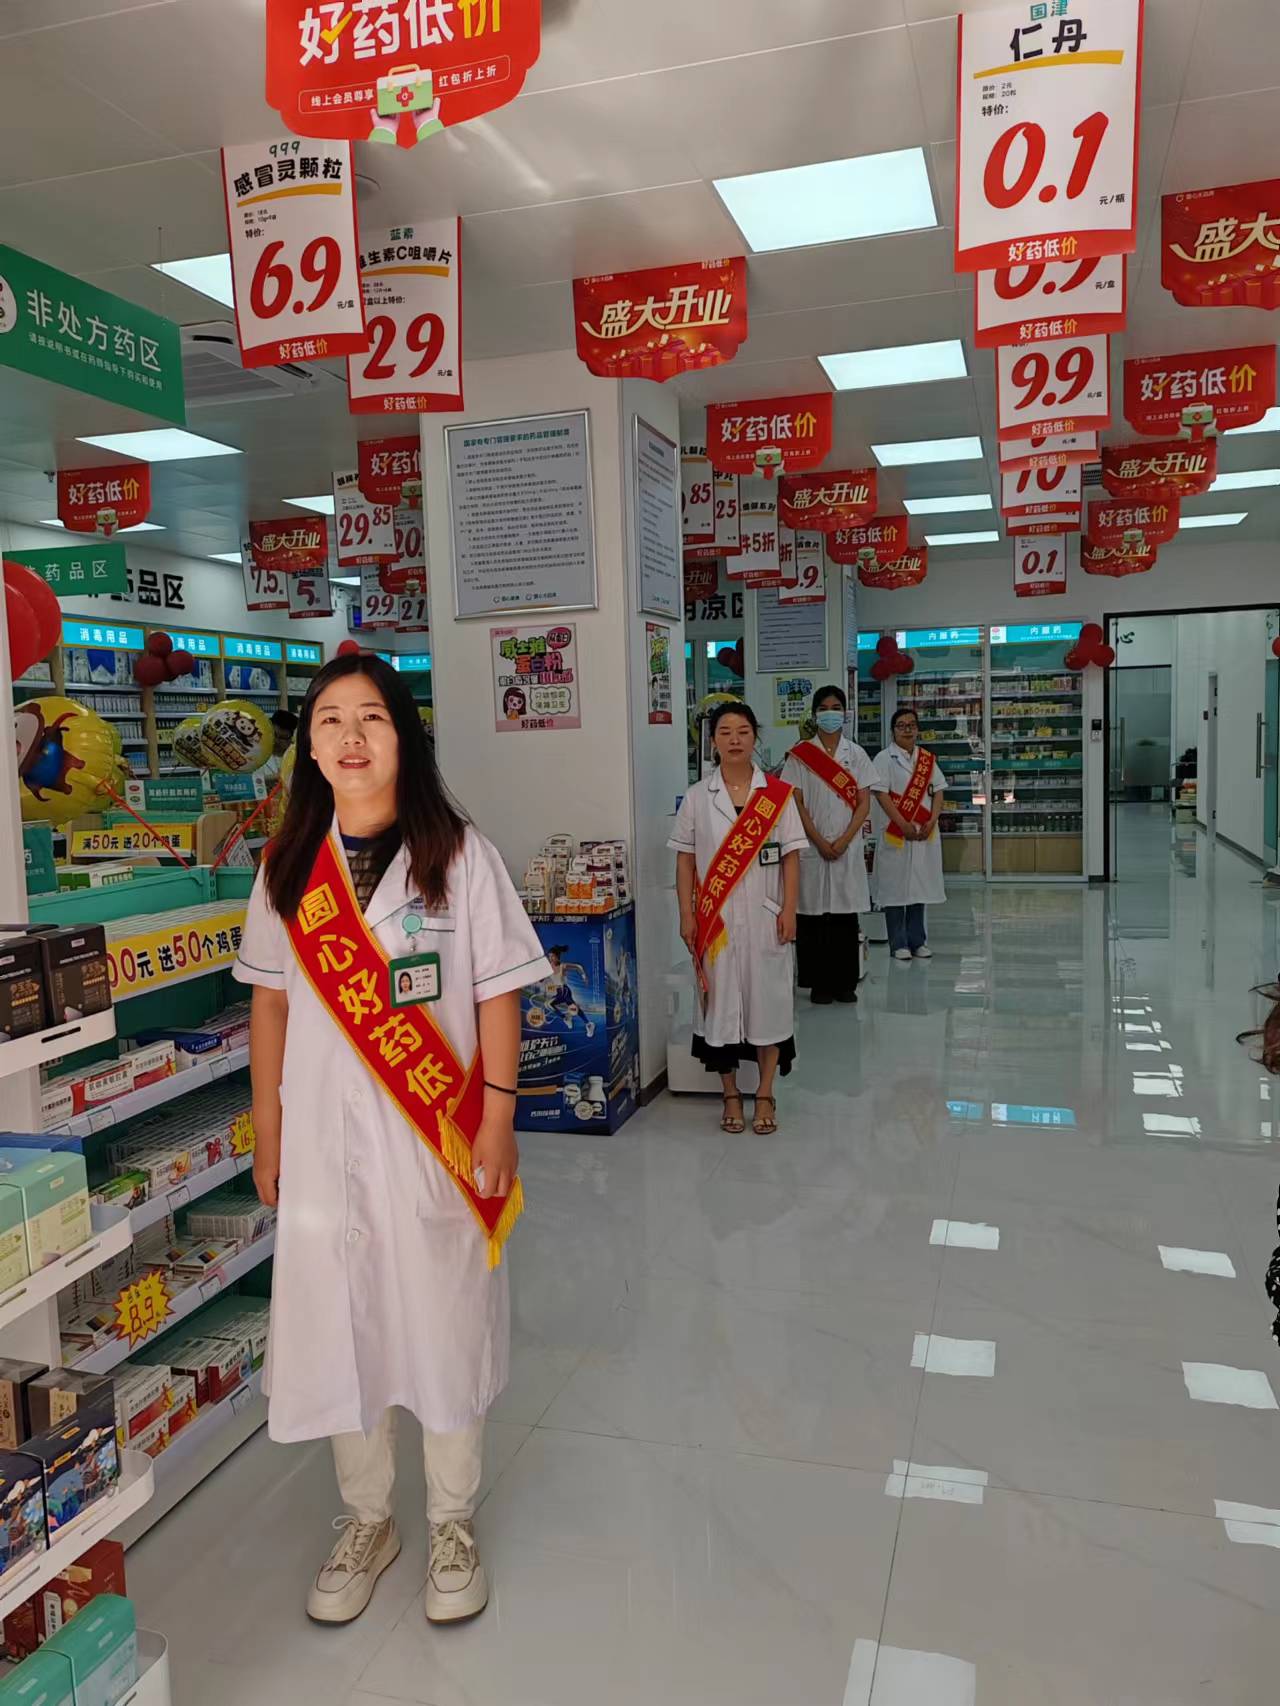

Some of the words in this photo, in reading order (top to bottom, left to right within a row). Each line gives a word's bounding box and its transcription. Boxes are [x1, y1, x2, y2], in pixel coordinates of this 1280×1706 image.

[1009, 19, 1088, 62] 仁丹
[438, 65, 497, 87] 红包折上折
[311, 89, 374, 107] 线上会员尊享
[981, 104, 1009, 117] 特价:
[268, 140, 300, 158] 999
[983, 111, 1109, 209] 0.1
[233, 157, 343, 197] 感冒灵颗粒
[1099, 193, 1126, 206] 元/瓶
[1008, 236, 1078, 262] 好药低价
[250, 236, 341, 319] 6.9
[581, 285, 732, 339] 盛大开业
[27, 289, 162, 372] 非处方药区
[1019, 321, 1077, 341] 好药低价
[278, 338, 328, 360] 好药低价
[362, 313, 445, 380] 29
[1011, 346, 1094, 410] 9.9
[1140, 364, 1256, 401] 好药低价
[384, 397, 427, 411] 好药低价
[721, 412, 816, 444] 好药低价
[1031, 420, 1075, 436] 好药低价
[1029, 453, 1067, 467] 好药低价
[1107, 452, 1207, 479] 盛大开业
[69, 478, 140, 506] 好药低价
[782, 481, 869, 510] 盛大开业
[1024, 504, 1057, 514] 好药低价
[1099, 505, 1168, 527] 好药低价
[253, 529, 320, 551] 盛大开业
[836, 525, 898, 545] 好药低价
[1021, 550, 1057, 574] 0.1
[366, 594, 394, 616] 9.9
[80, 627, 128, 646] 消毒用品
[515, 651, 563, 673] 蛋白粉
[82, 833, 119, 849] 满50元
[123, 831, 181, 850] 送20个鸡蛋
[702, 795, 777, 918] 圆心好药低价
[157, 925, 243, 973] 送50个鸡蛋
[129, 1296, 153, 1333] 8.9
